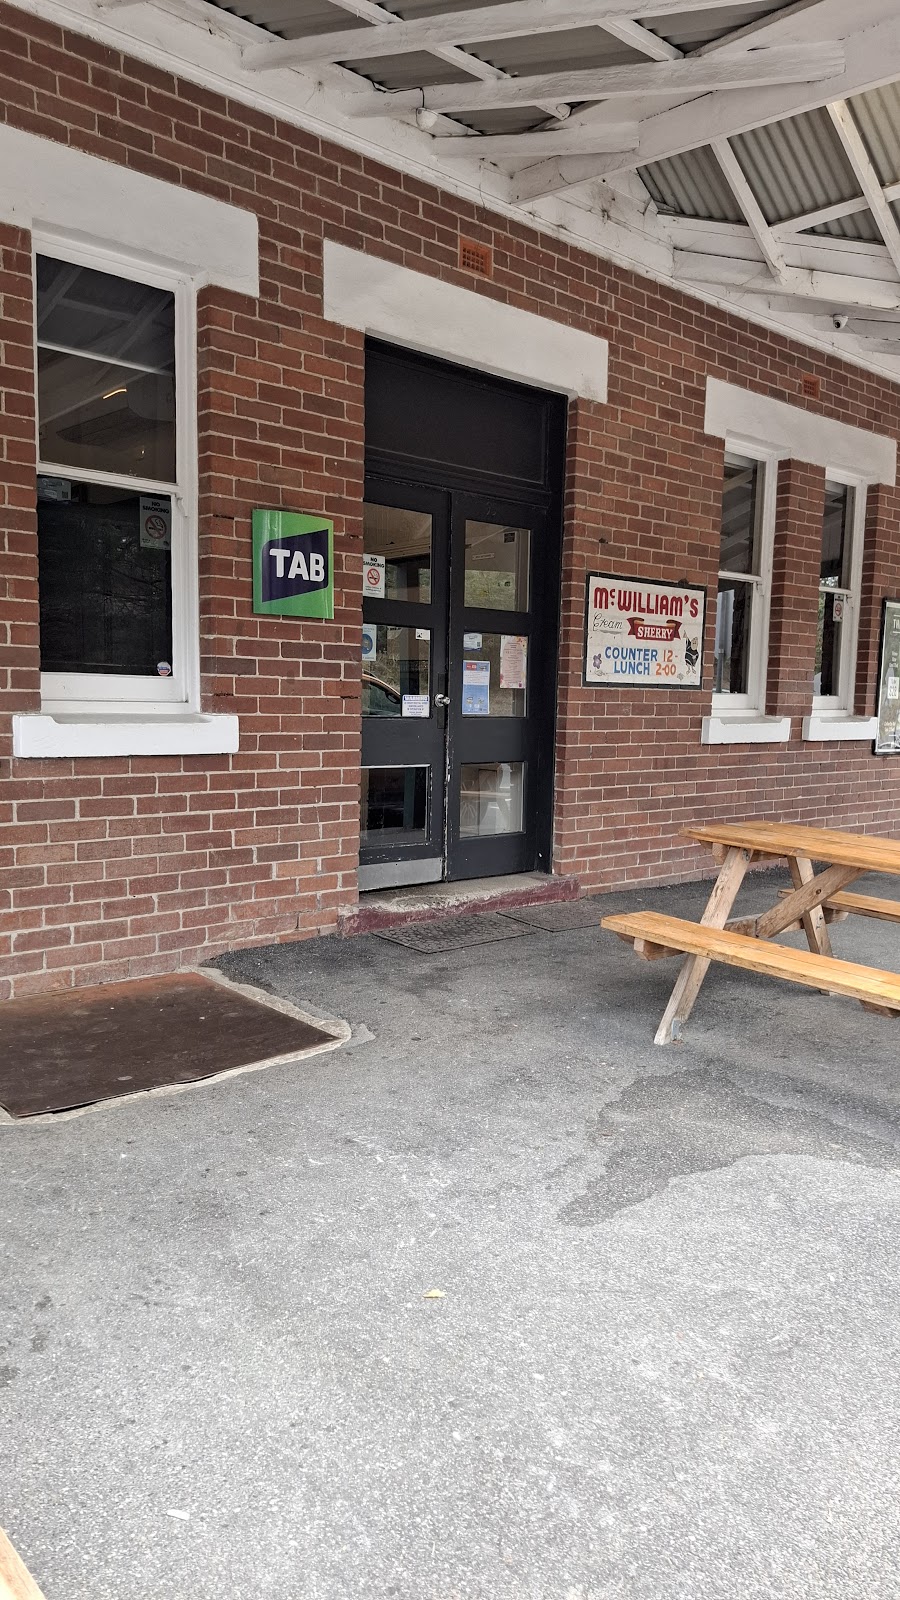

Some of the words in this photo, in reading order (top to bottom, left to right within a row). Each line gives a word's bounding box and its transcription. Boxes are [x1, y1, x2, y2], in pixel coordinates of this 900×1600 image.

[142, 506, 169, 514] SMOKING
[270, 549, 325, 582] TAB
[592, 612, 623, 632] Cream
[637, 627, 673, 639] SHERRY
[604, 646, 658, 662] COUNTER
[613, 661, 650, 675] LUNCH
